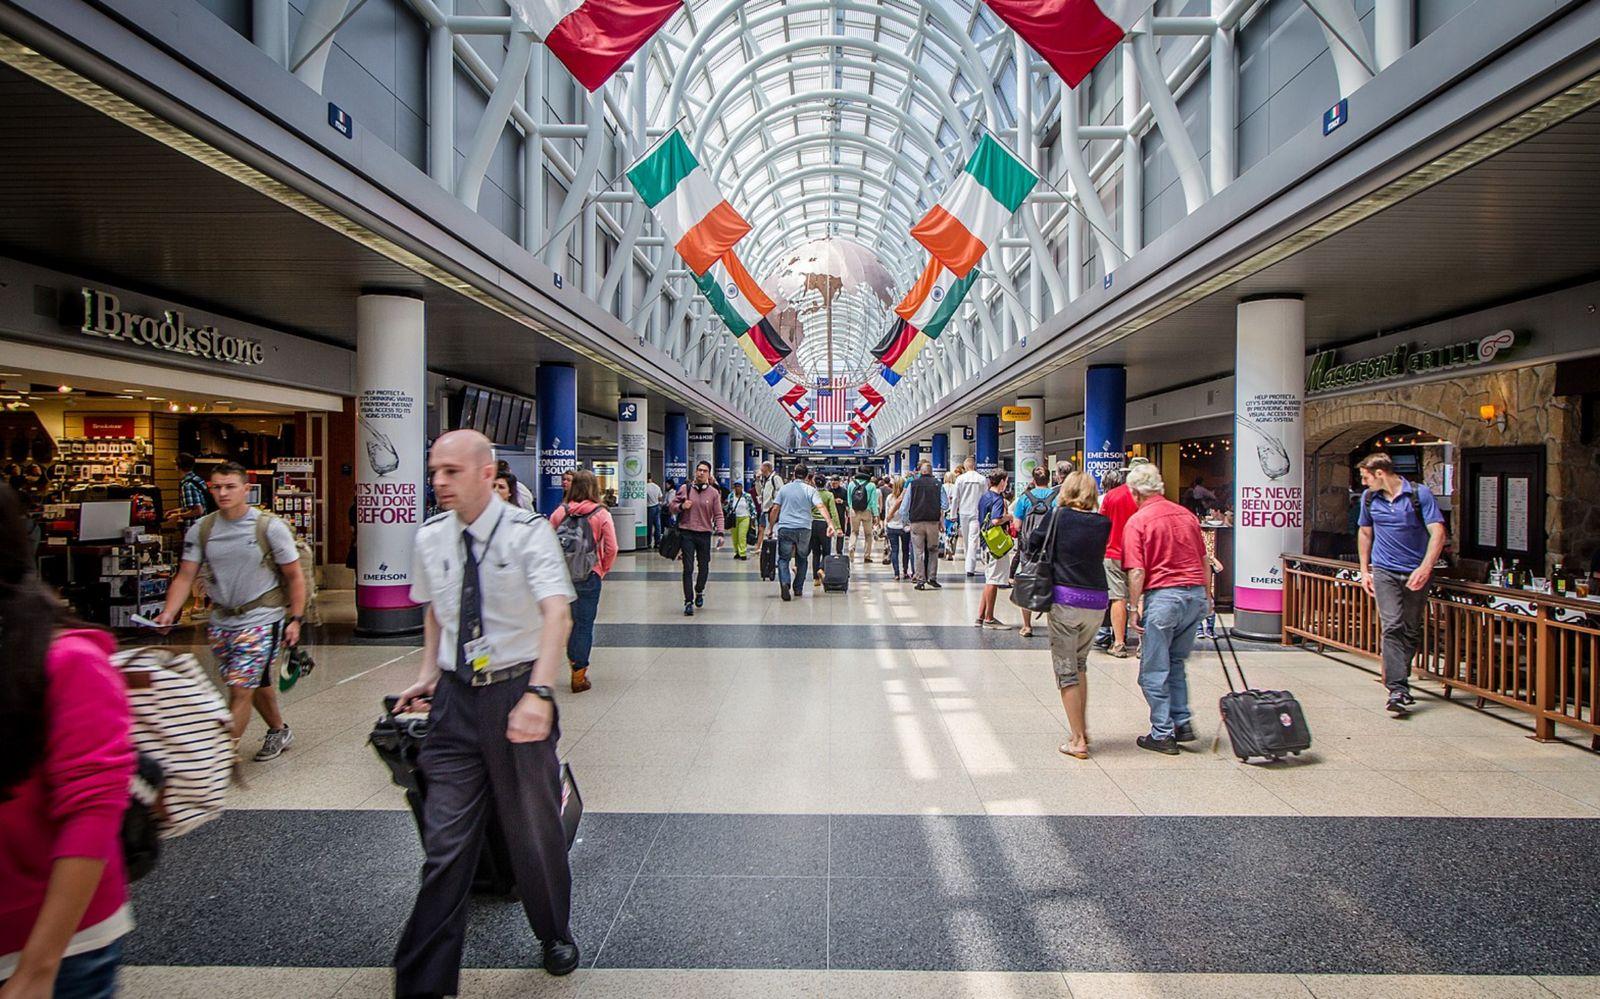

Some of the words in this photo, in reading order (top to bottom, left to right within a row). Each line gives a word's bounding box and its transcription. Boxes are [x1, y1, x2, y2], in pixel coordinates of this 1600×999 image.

[81, 287, 265, 365] Brookstone
[1408, 340, 1481, 374] GRILL
[374, 484, 416, 494] NEVER
[1242, 487, 1262, 498] IT'S
[1266, 487, 1302, 498] NEVER
[383, 496, 416, 506] DONE
[1242, 500, 1270, 510] BEEN
[358, 508, 416, 523] BEFORE
[1242, 511, 1302, 527] BEFORE
